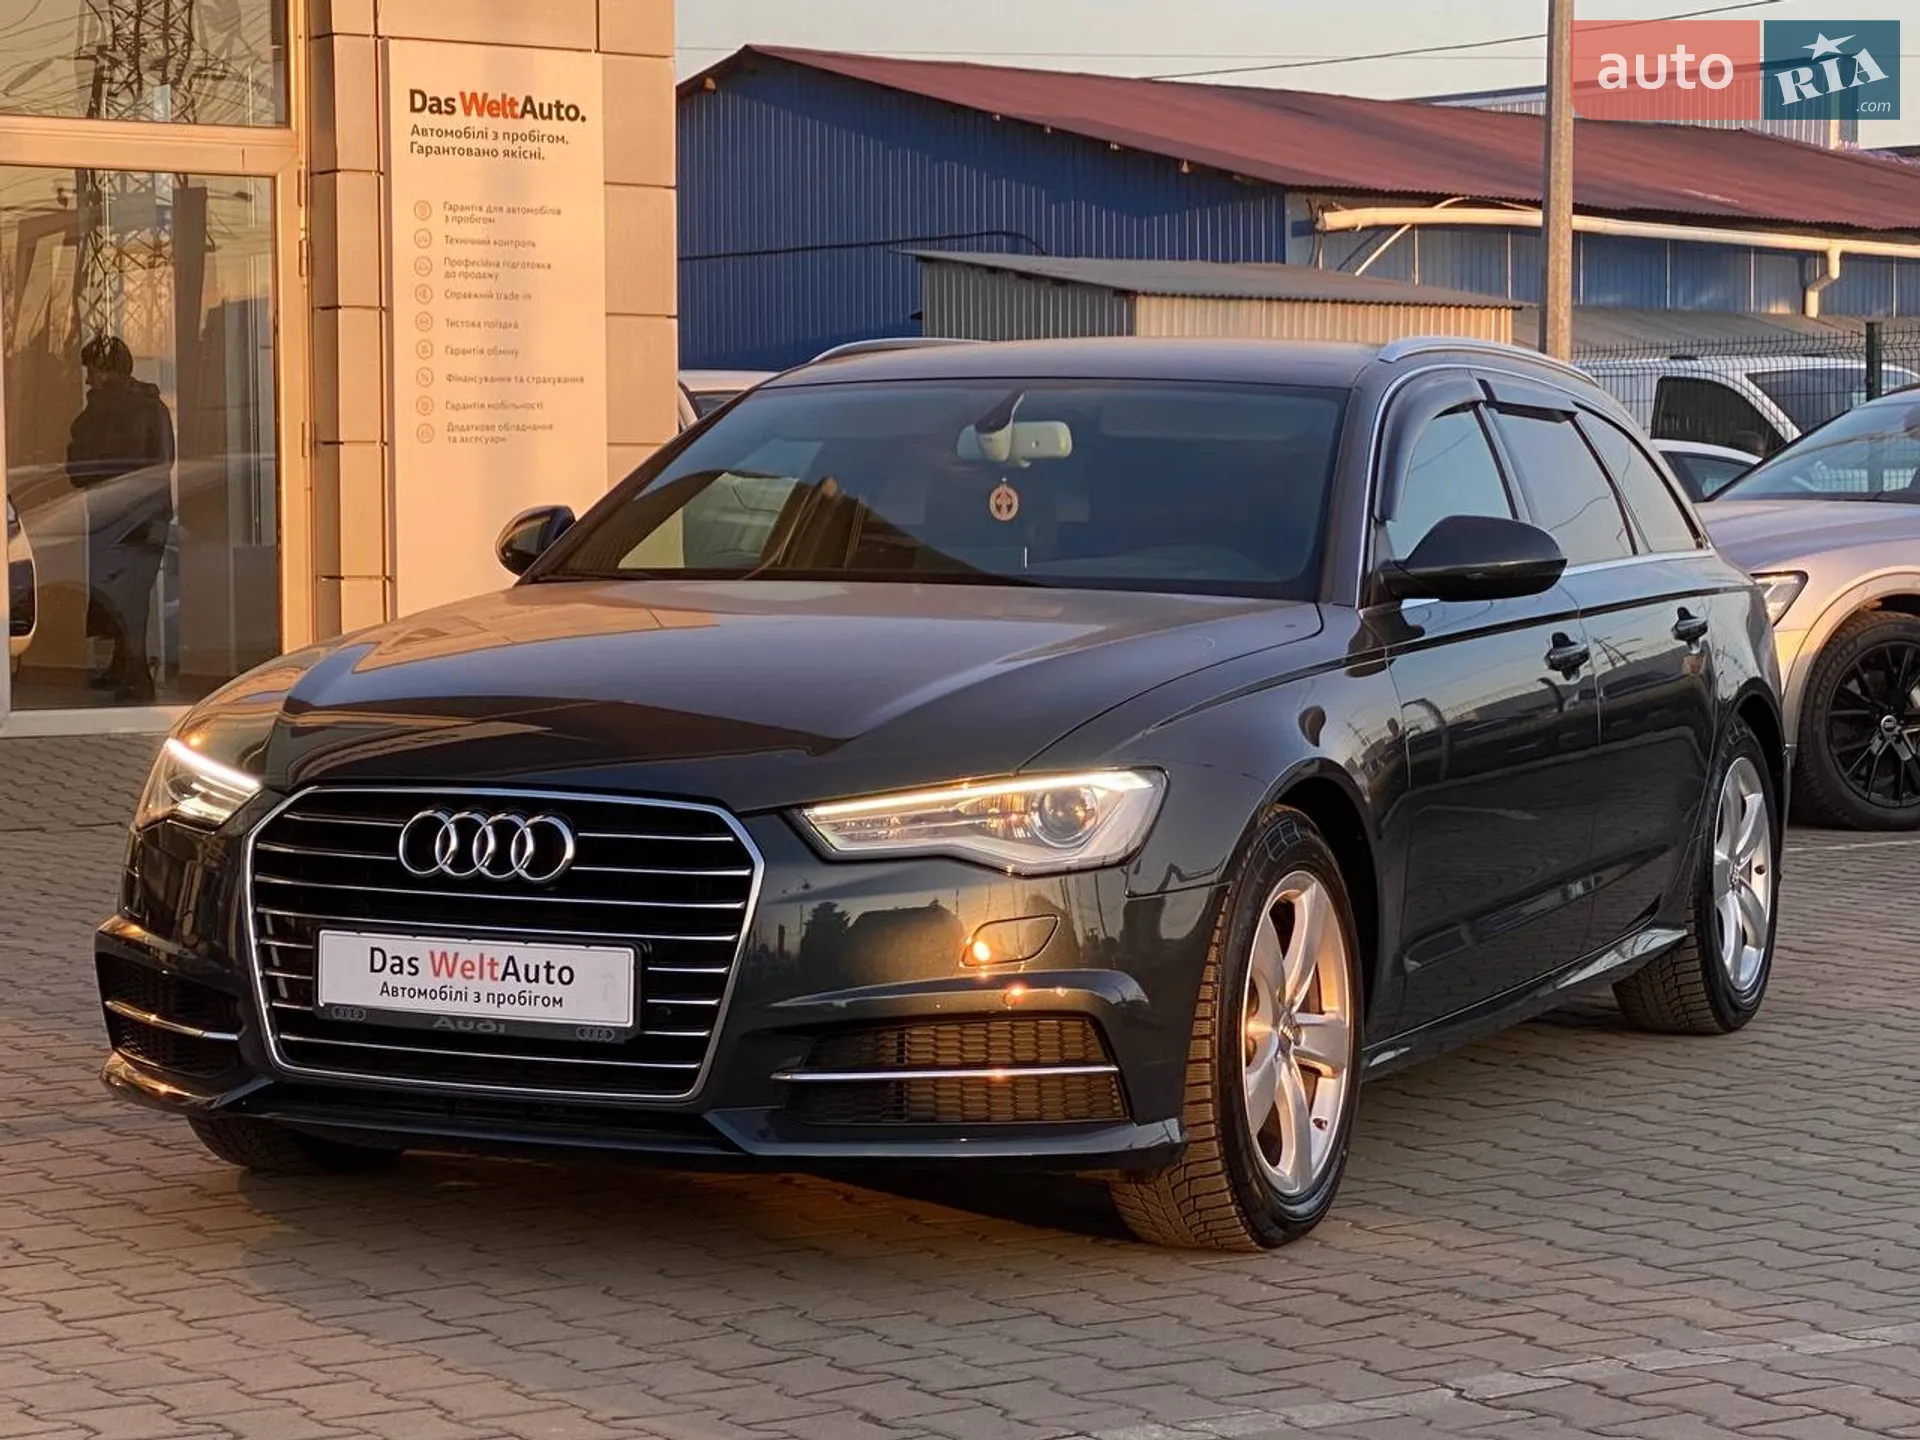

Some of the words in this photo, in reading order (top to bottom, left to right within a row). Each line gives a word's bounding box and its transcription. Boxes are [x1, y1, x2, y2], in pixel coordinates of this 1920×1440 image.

[409, 88, 457, 116] Das
[410, 124, 489, 140] Автомобілі
[492, 131, 499, 140] з
[410, 141, 499, 159] Гарантовано
[369, 946, 420, 977] Das
[429, 951, 575, 986] WeltAuto
[379, 981, 469, 1002] Автомобілі
[472, 992, 482, 1004] з
[486, 990, 564, 1010] пробігом
